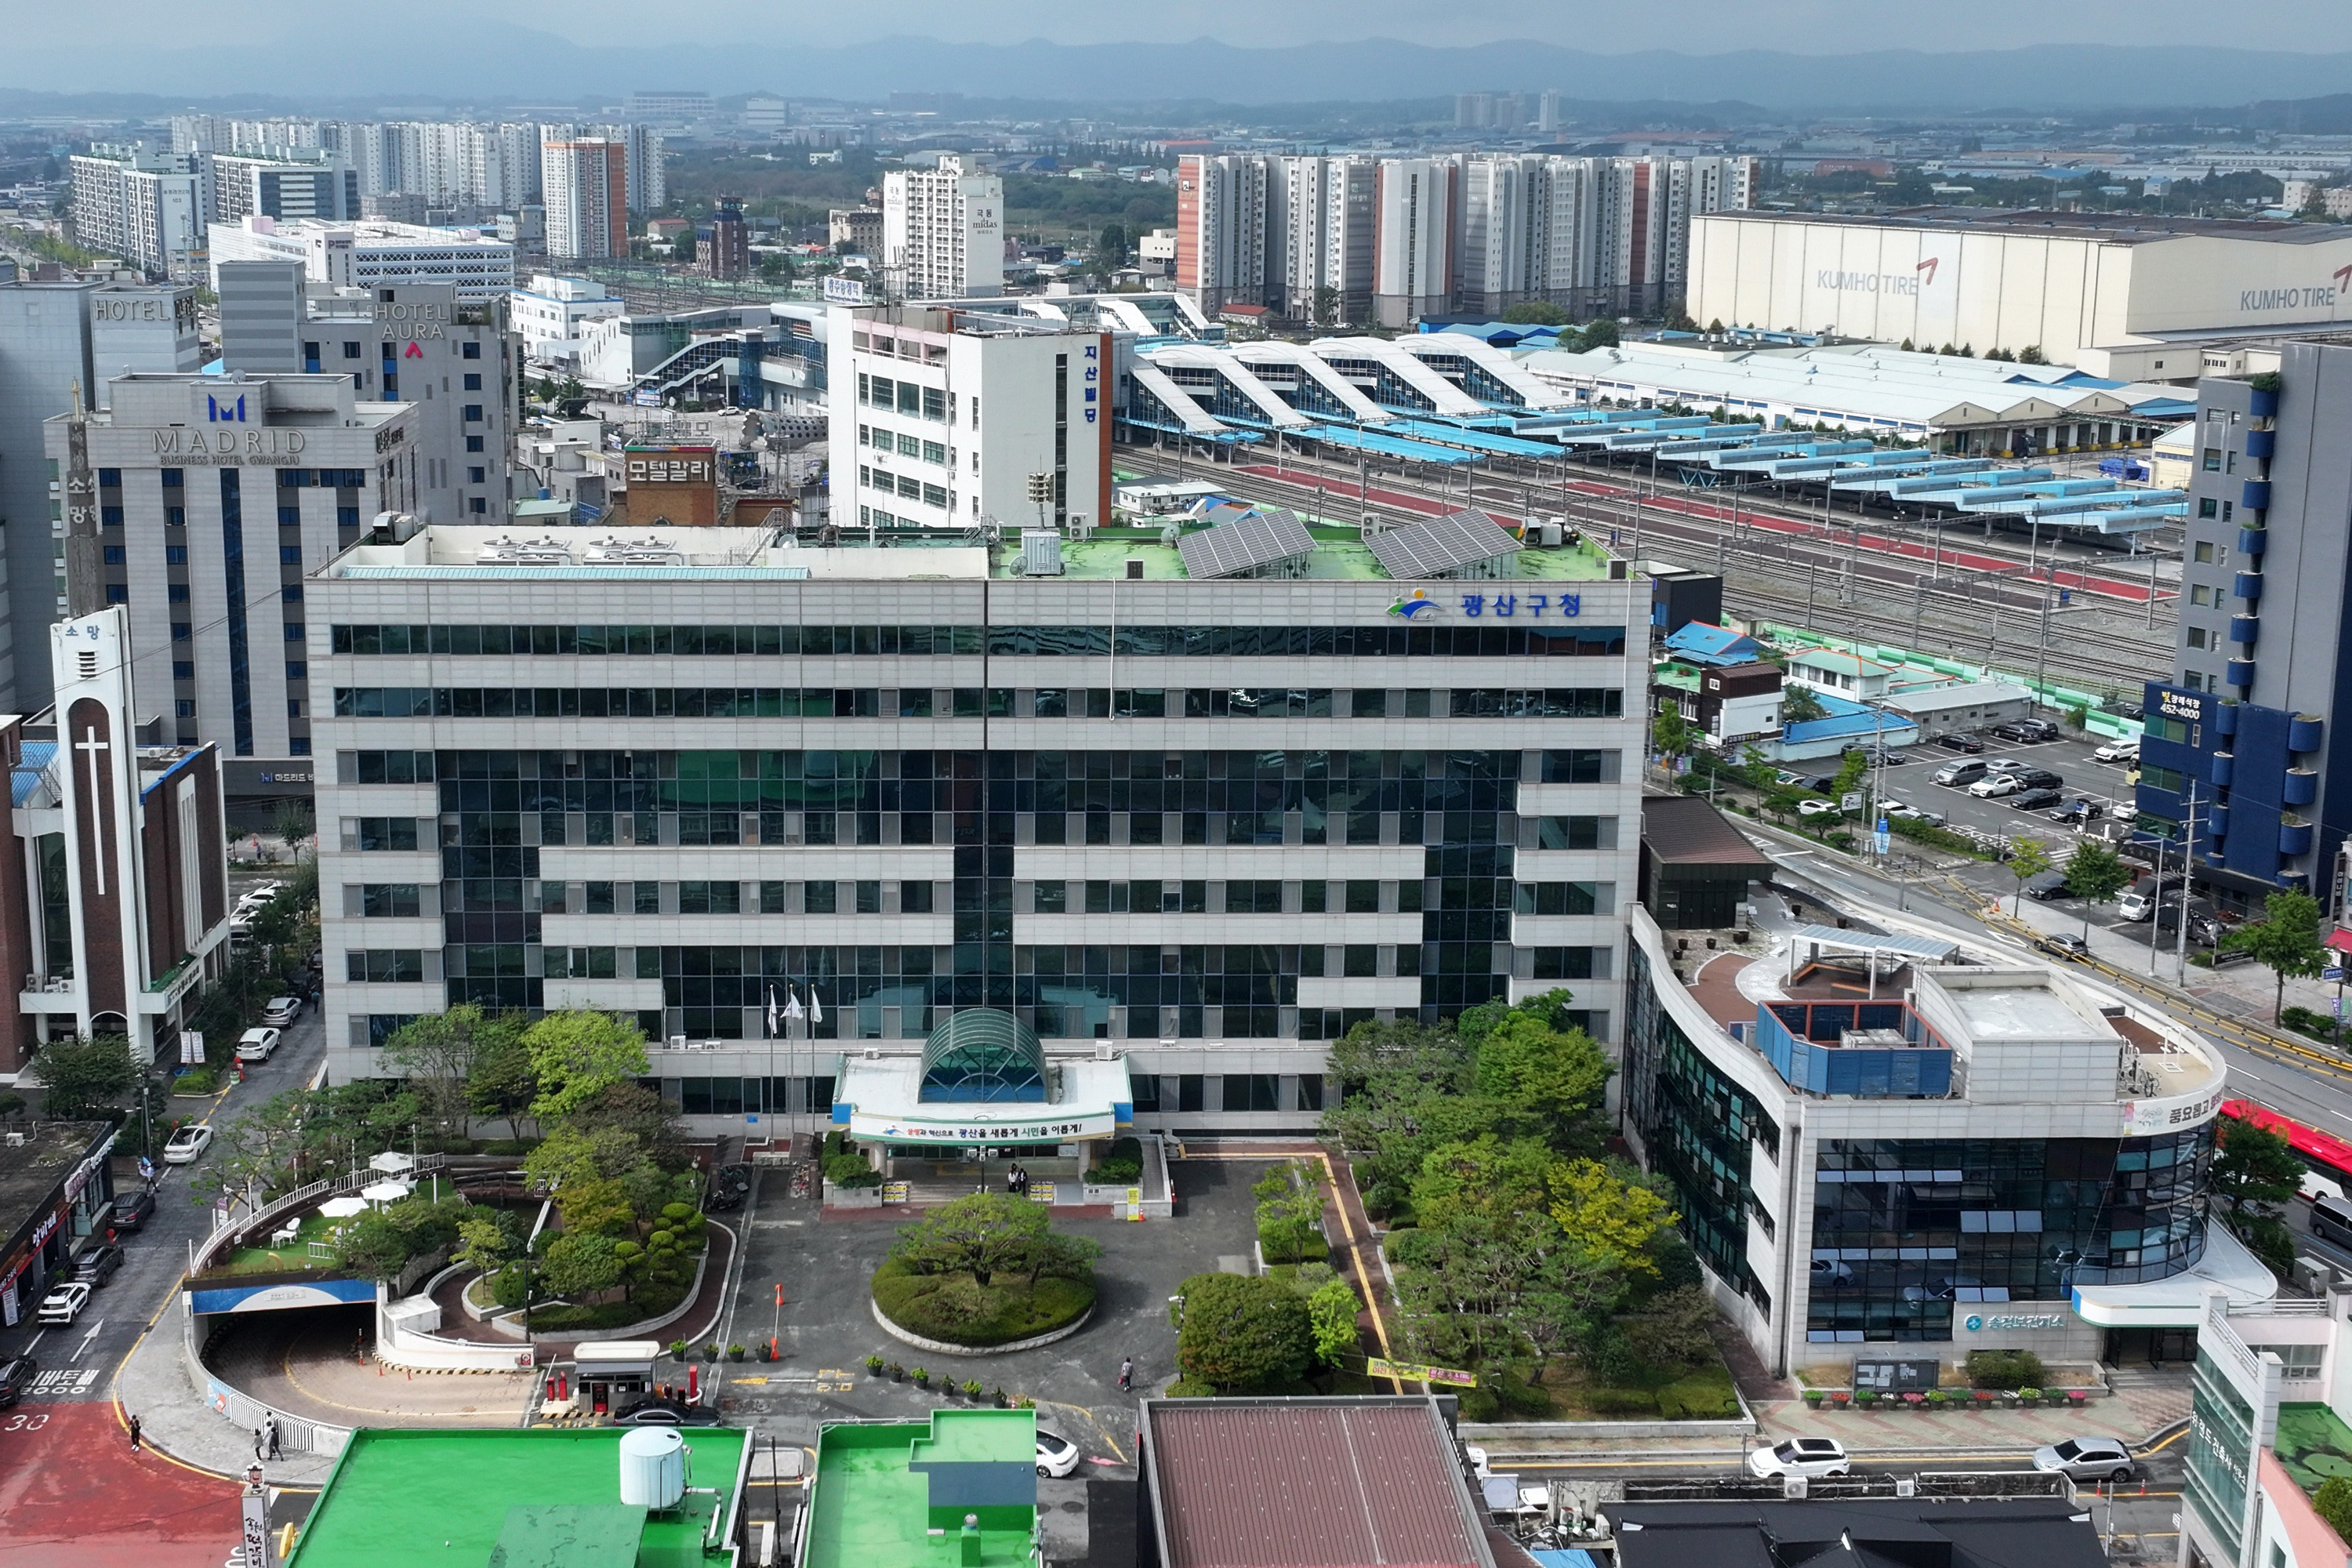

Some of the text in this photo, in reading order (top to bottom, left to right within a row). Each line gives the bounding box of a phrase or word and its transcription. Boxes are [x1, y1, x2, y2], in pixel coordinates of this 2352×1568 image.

[972, 218, 998, 228] midas
[1817, 270, 1918, 296] KUMHO TIRE
[2241, 287, 2336, 310] KUMHO TIRE
[94, 299, 171, 321] HOTEL
[375, 303, 449, 321] HOTEL
[381, 323, 445, 340] AURA
[1084, 346, 1098, 423] 지산빌딩
[151, 430, 305, 453] MADRID
[160, 455, 300, 466] BUSINESS HOTEL GWANGJU
[1461, 593, 1581, 618] 광산구청
[65, 625, 100, 641] 소망
[2160, 703, 2200, 720] 452-4000
[274, 773, 307, 782] 마드리드
[2169, 1099, 2209, 1124] 풍요롭고
[959, 1129, 986, 1138] 광산을
[990, 1127, 1018, 1137] 새롭게
[1022, 1127, 1047, 1137] 시민을
[1987, 1315, 2064, 1328] 송정보건지소
[5, 1414, 49, 1432] 30
